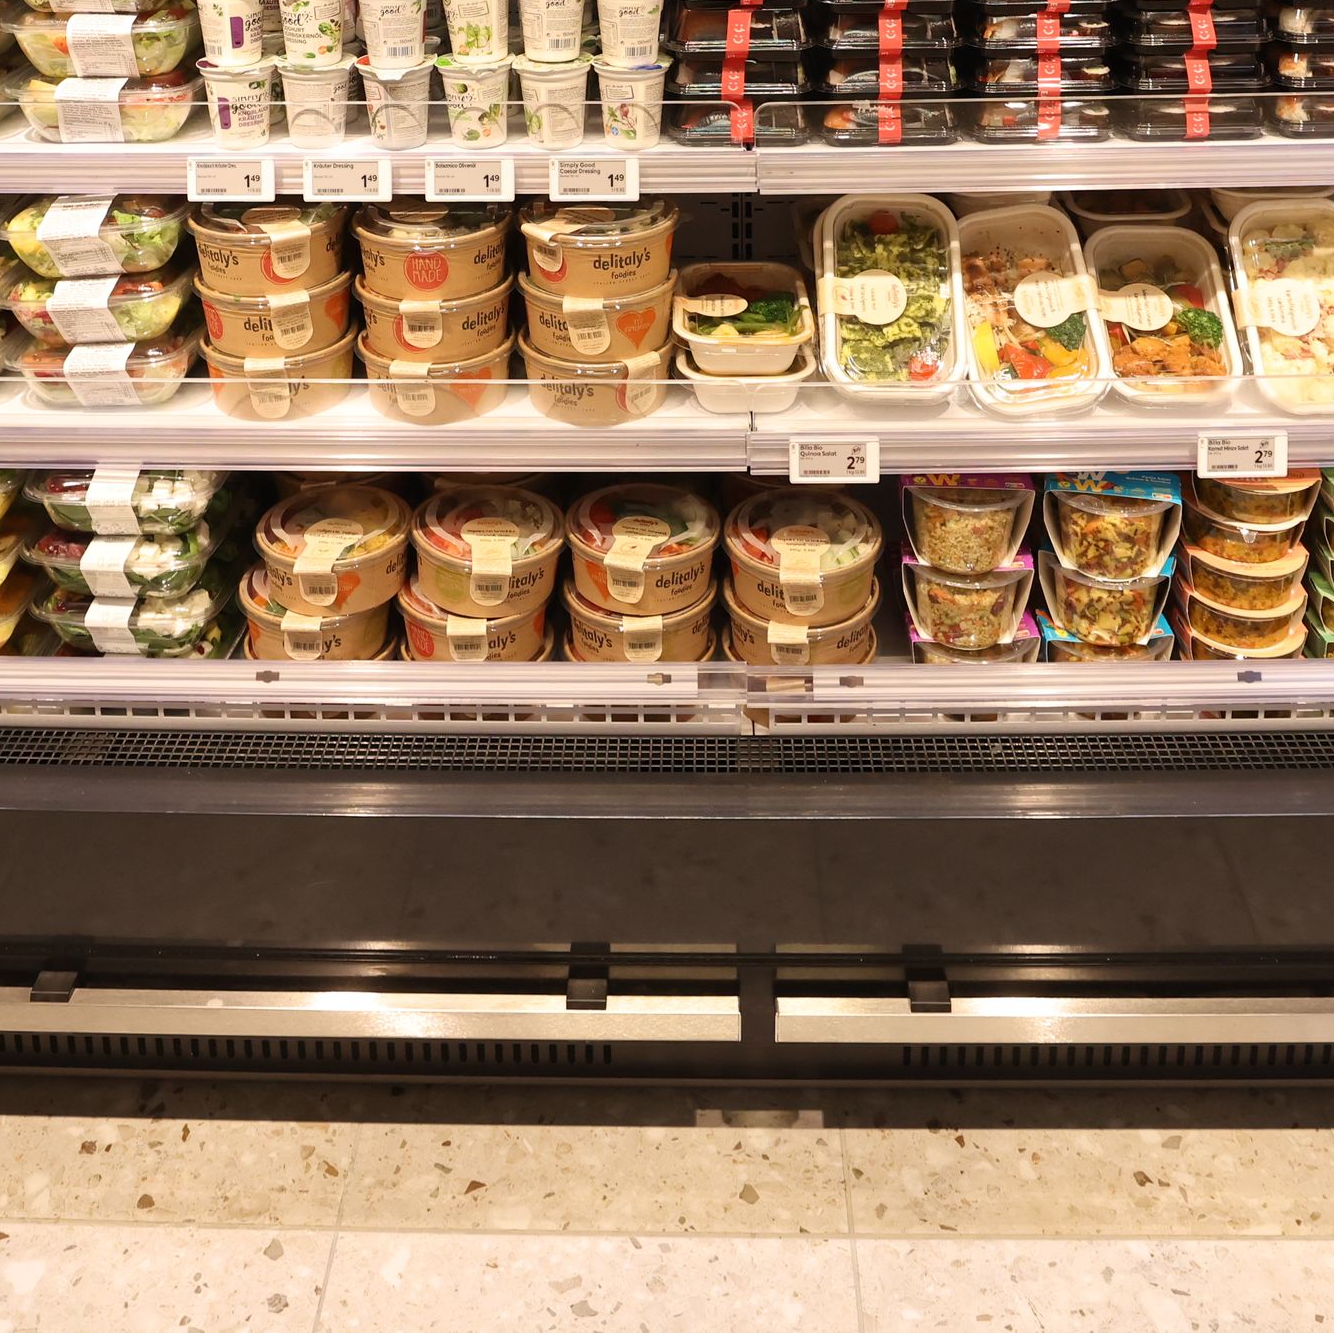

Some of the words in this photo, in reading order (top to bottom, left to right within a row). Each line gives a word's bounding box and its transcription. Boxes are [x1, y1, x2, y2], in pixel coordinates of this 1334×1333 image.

[380, 7, 401, 18] good
[238, 119, 264, 128] DRESSING
[578, 168, 601, 176] Dressing
[593, 247, 651, 271] delitaly's
[411, 259, 442, 273] HAND
[411, 271, 443, 284] MADE
[611, 269, 637, 280] foodies
[655, 560, 706, 589] delitaly's
[670, 583, 692, 597] foodies
